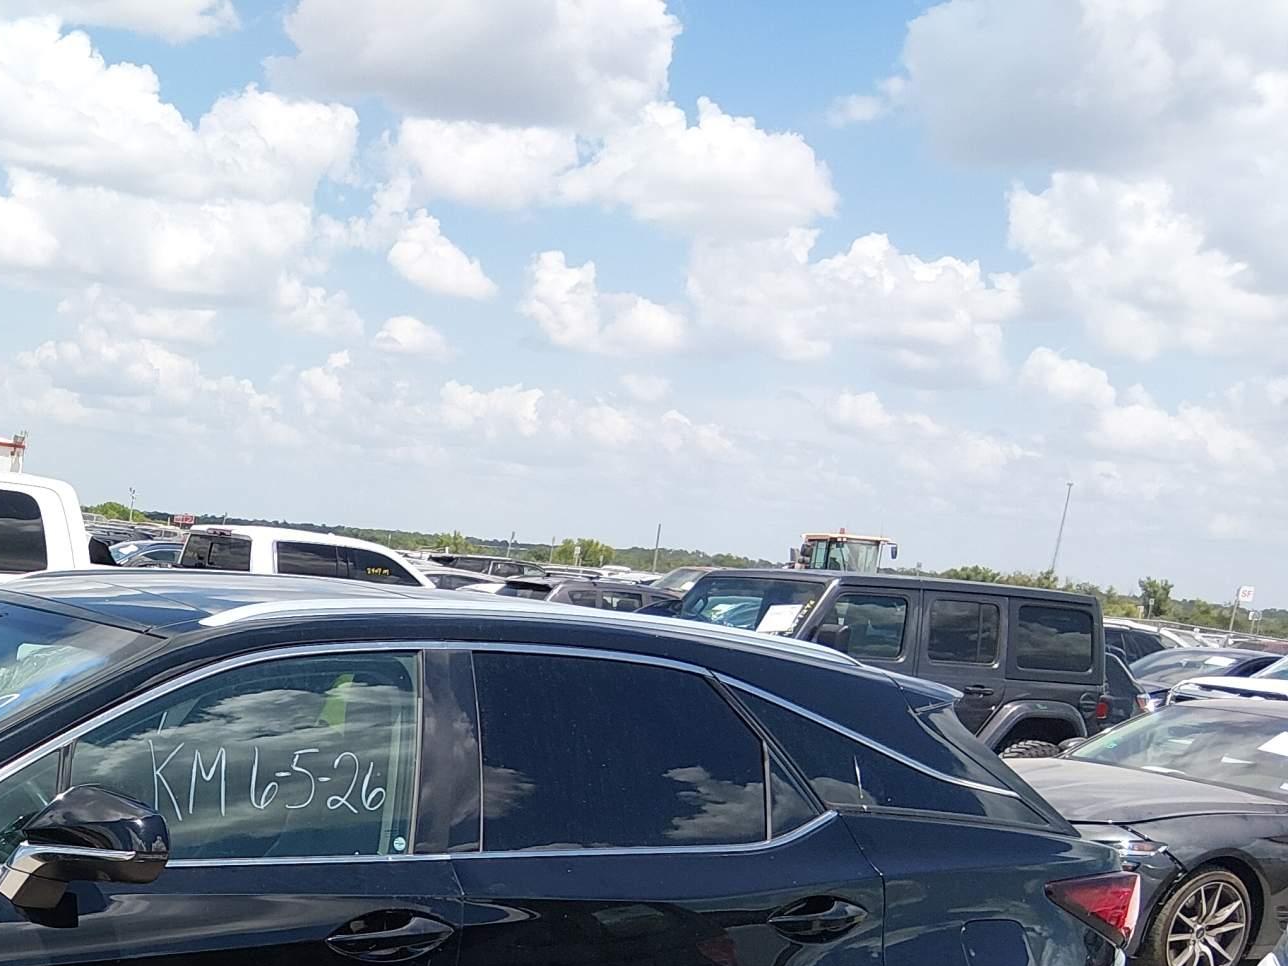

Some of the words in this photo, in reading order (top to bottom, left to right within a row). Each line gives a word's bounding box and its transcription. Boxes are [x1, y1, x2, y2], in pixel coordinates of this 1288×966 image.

[1241, 589, 1254, 598] SF
[148, 739, 227, 821] KM
[249, 745, 387, 814] 6-5-26
